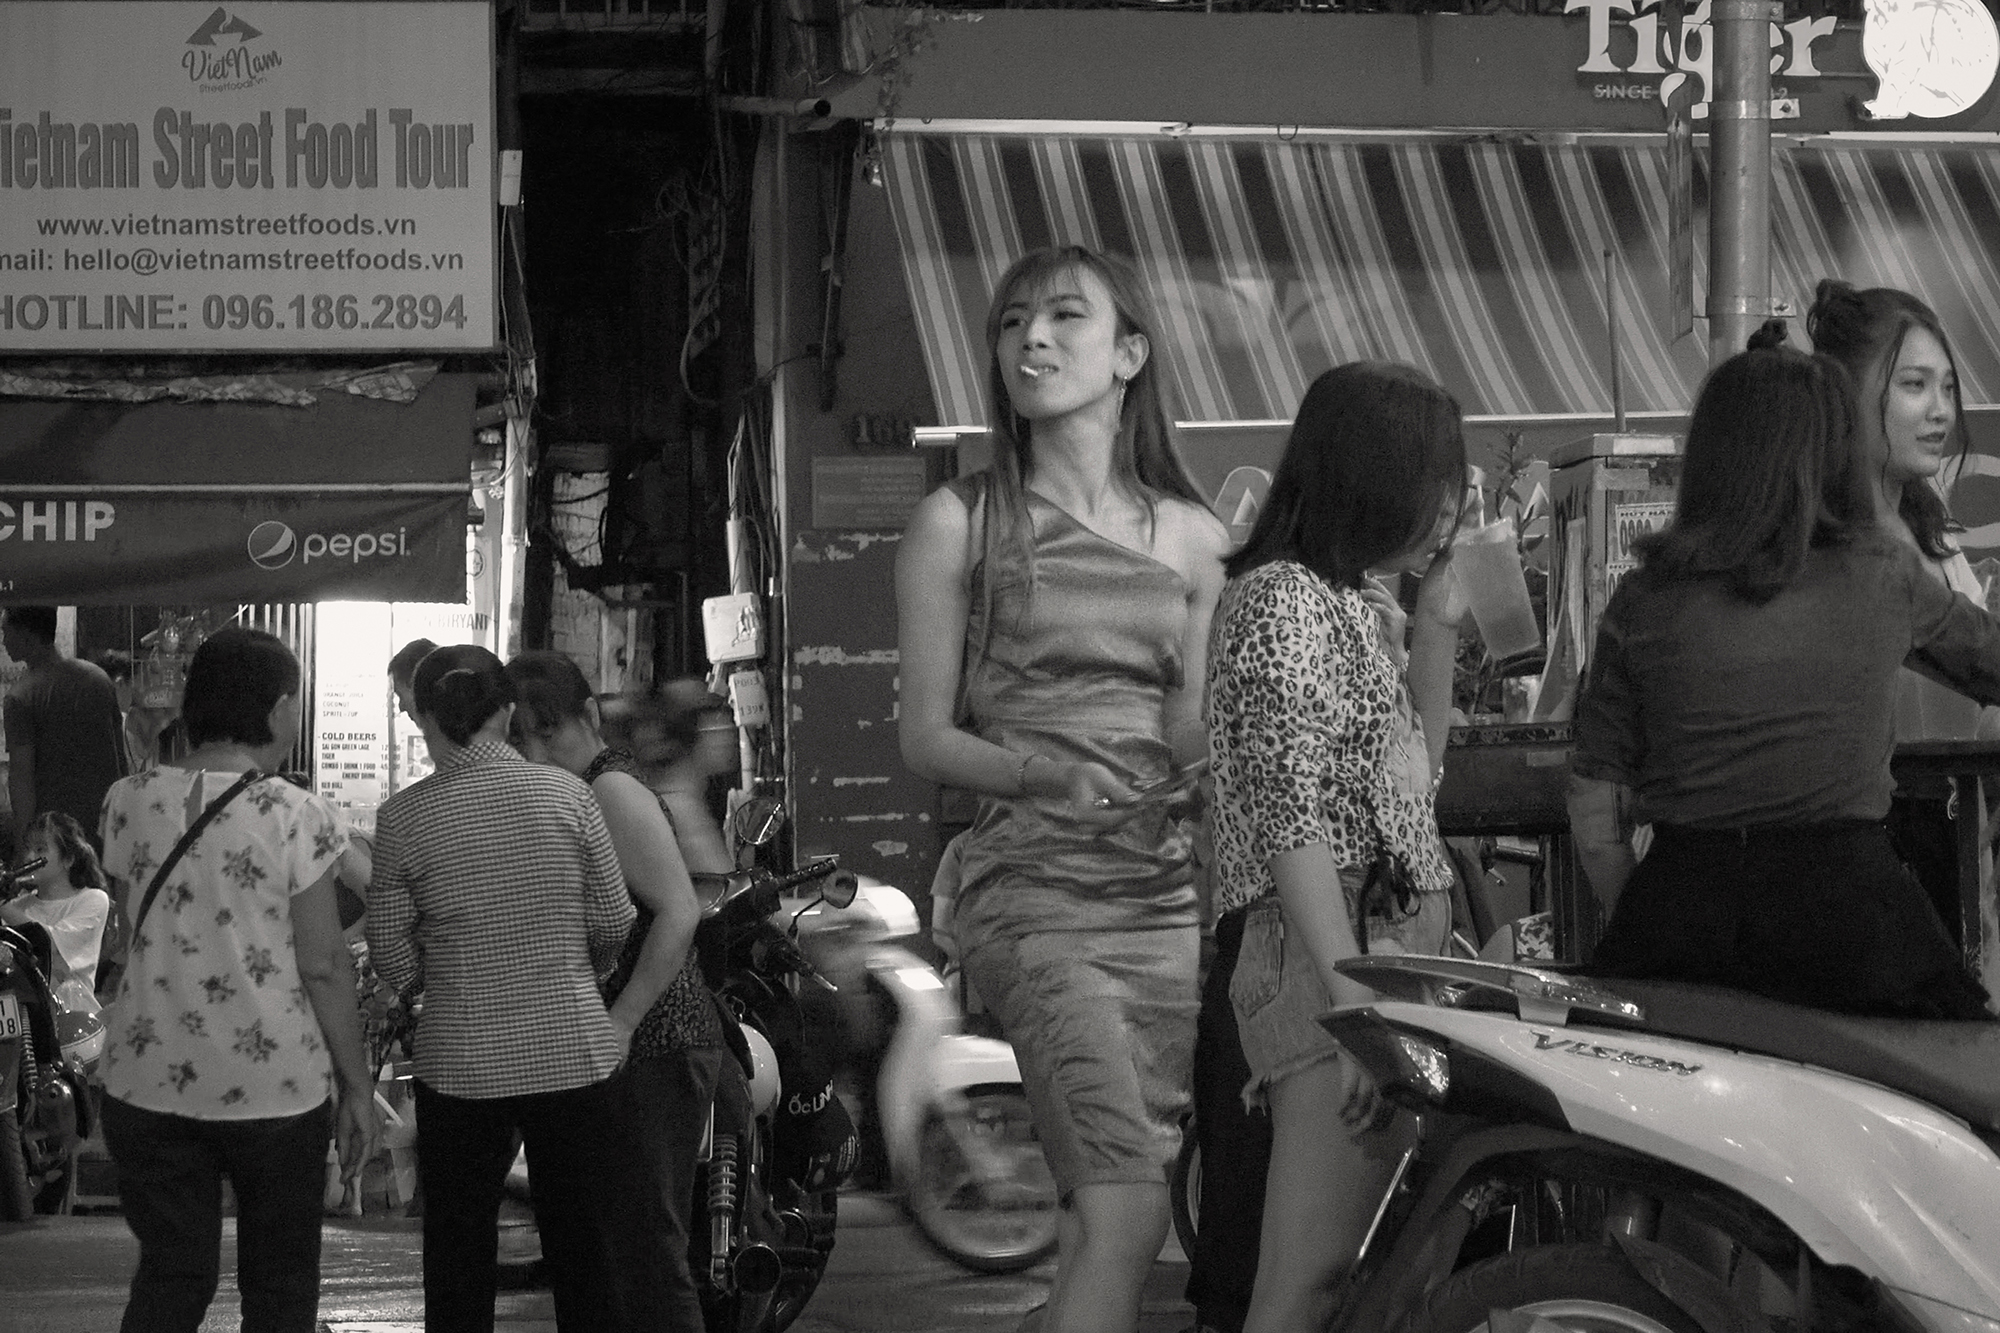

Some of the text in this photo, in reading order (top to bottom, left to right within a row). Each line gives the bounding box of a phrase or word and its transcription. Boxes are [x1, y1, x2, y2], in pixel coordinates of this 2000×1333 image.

[1564, 0, 1837, 108] Tigr
[1593, 84, 1653, 99] SINCE
[152, 106, 274, 190] Street
[285, 108, 378, 190] Food
[388, 108, 474, 189] Tour
[37, 213, 416, 236] www.vietnamstreetfoods.vn
[64, 248, 464, 276] hello@vietnamstreetfoods.vn
[202, 294, 468, 330] 096.186.2894
[303, 526, 406, 564] pepsi
[322, 732, 377, 741] COLD BEERS
